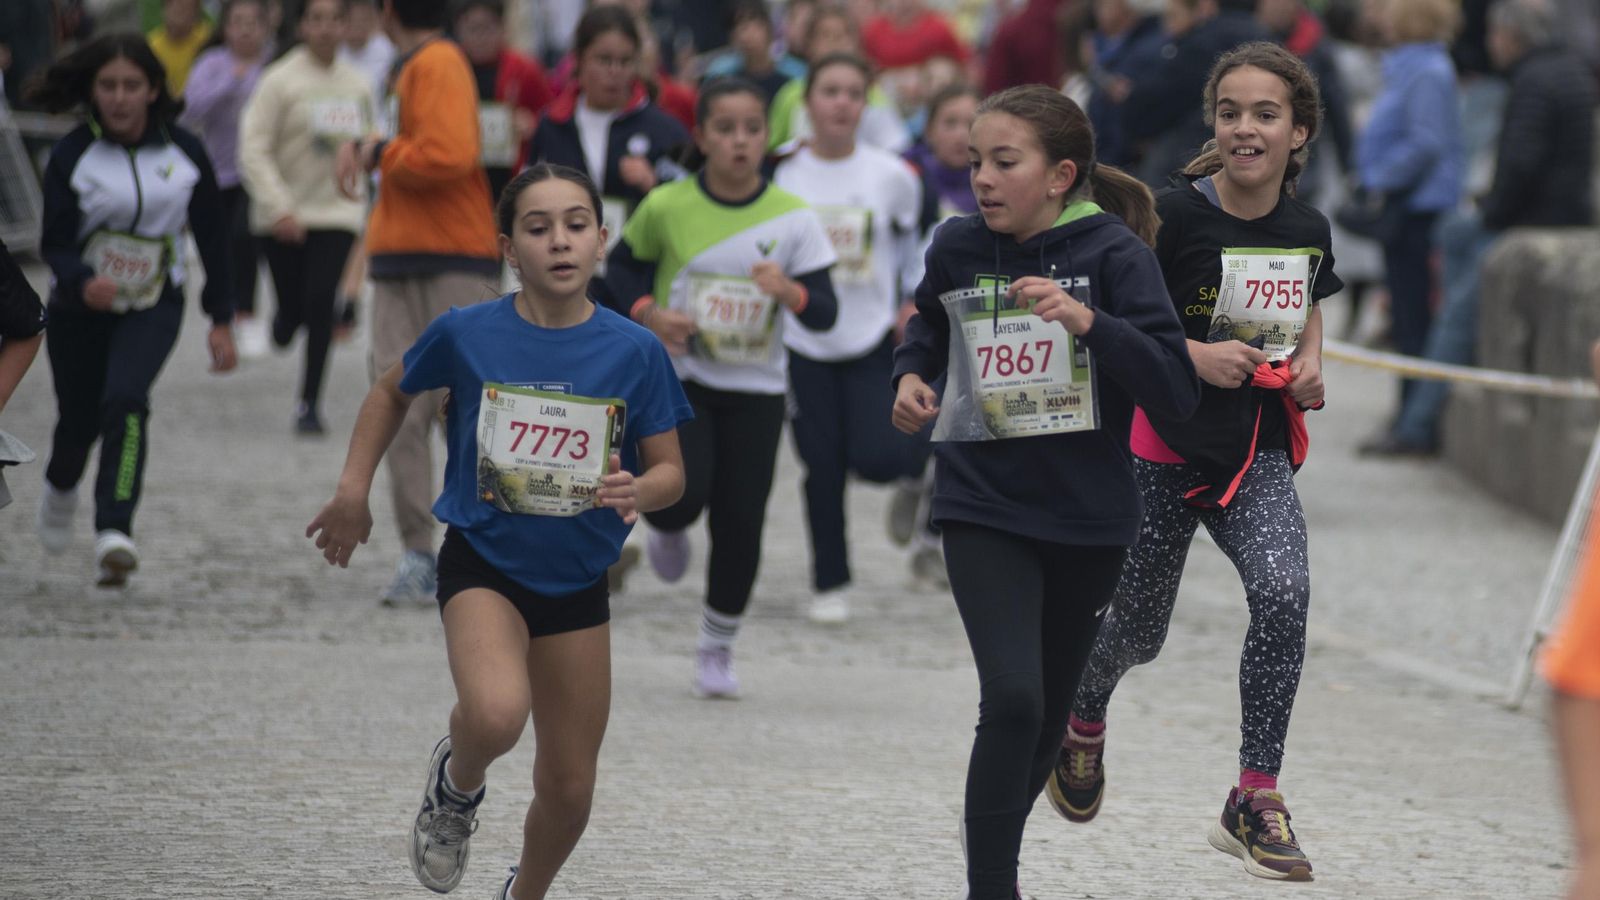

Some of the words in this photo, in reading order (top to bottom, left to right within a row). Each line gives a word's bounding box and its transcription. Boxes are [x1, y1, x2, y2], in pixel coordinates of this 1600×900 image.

[1269, 261, 1285, 271] MAIO
[1245, 280, 1304, 309] 7955
[976, 340, 1053, 379] 7867
[540, 405, 566, 418] LAURA
[1046, 395, 1081, 408] XLVIII
[510, 421, 590, 460] 7773
